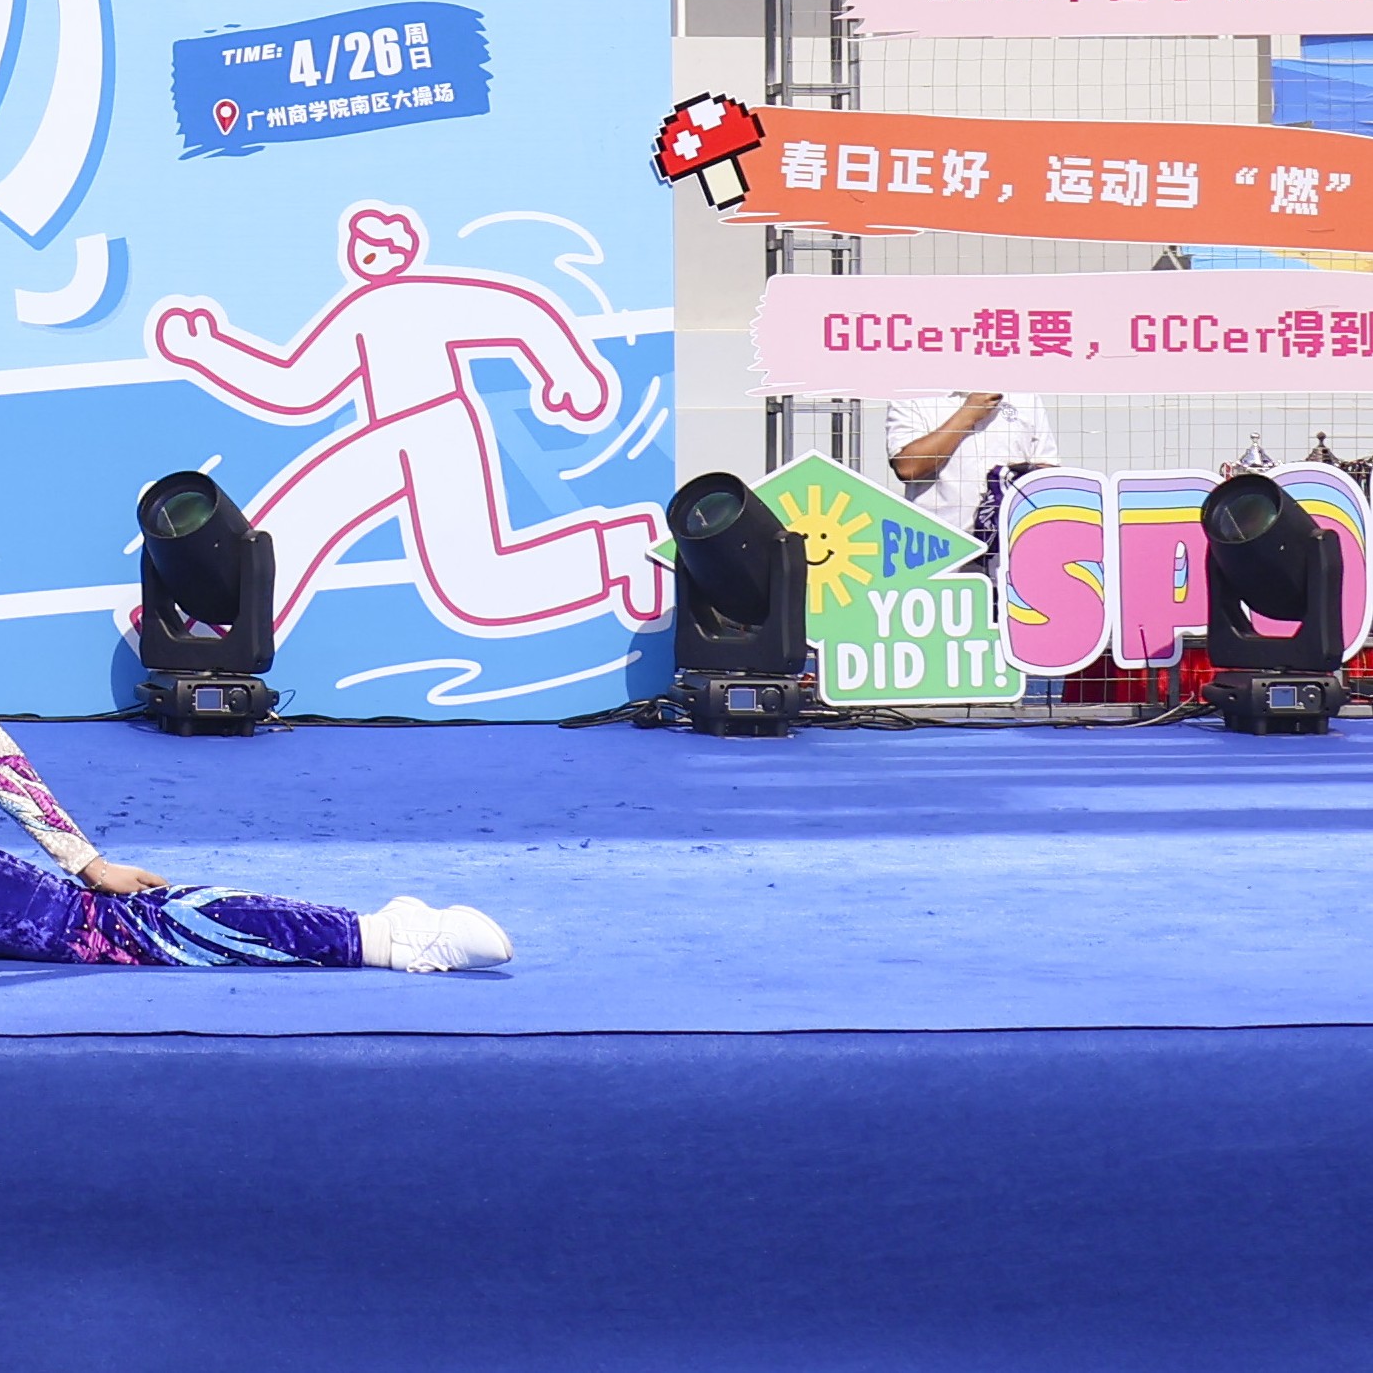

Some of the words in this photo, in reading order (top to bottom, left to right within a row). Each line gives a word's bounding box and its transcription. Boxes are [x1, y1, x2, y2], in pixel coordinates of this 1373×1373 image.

[221, 43, 283, 66] TIME:
[289, 27, 403, 88] 4/26
[404, 22, 433, 70] 周日
[246, 82, 455, 131] 广州商学院南区大操场
[882, 518, 951, 579] FUN
[867, 587, 973, 638] YOU
[837, 641, 925, 690] DID
[946, 639, 1008, 688] IT!
